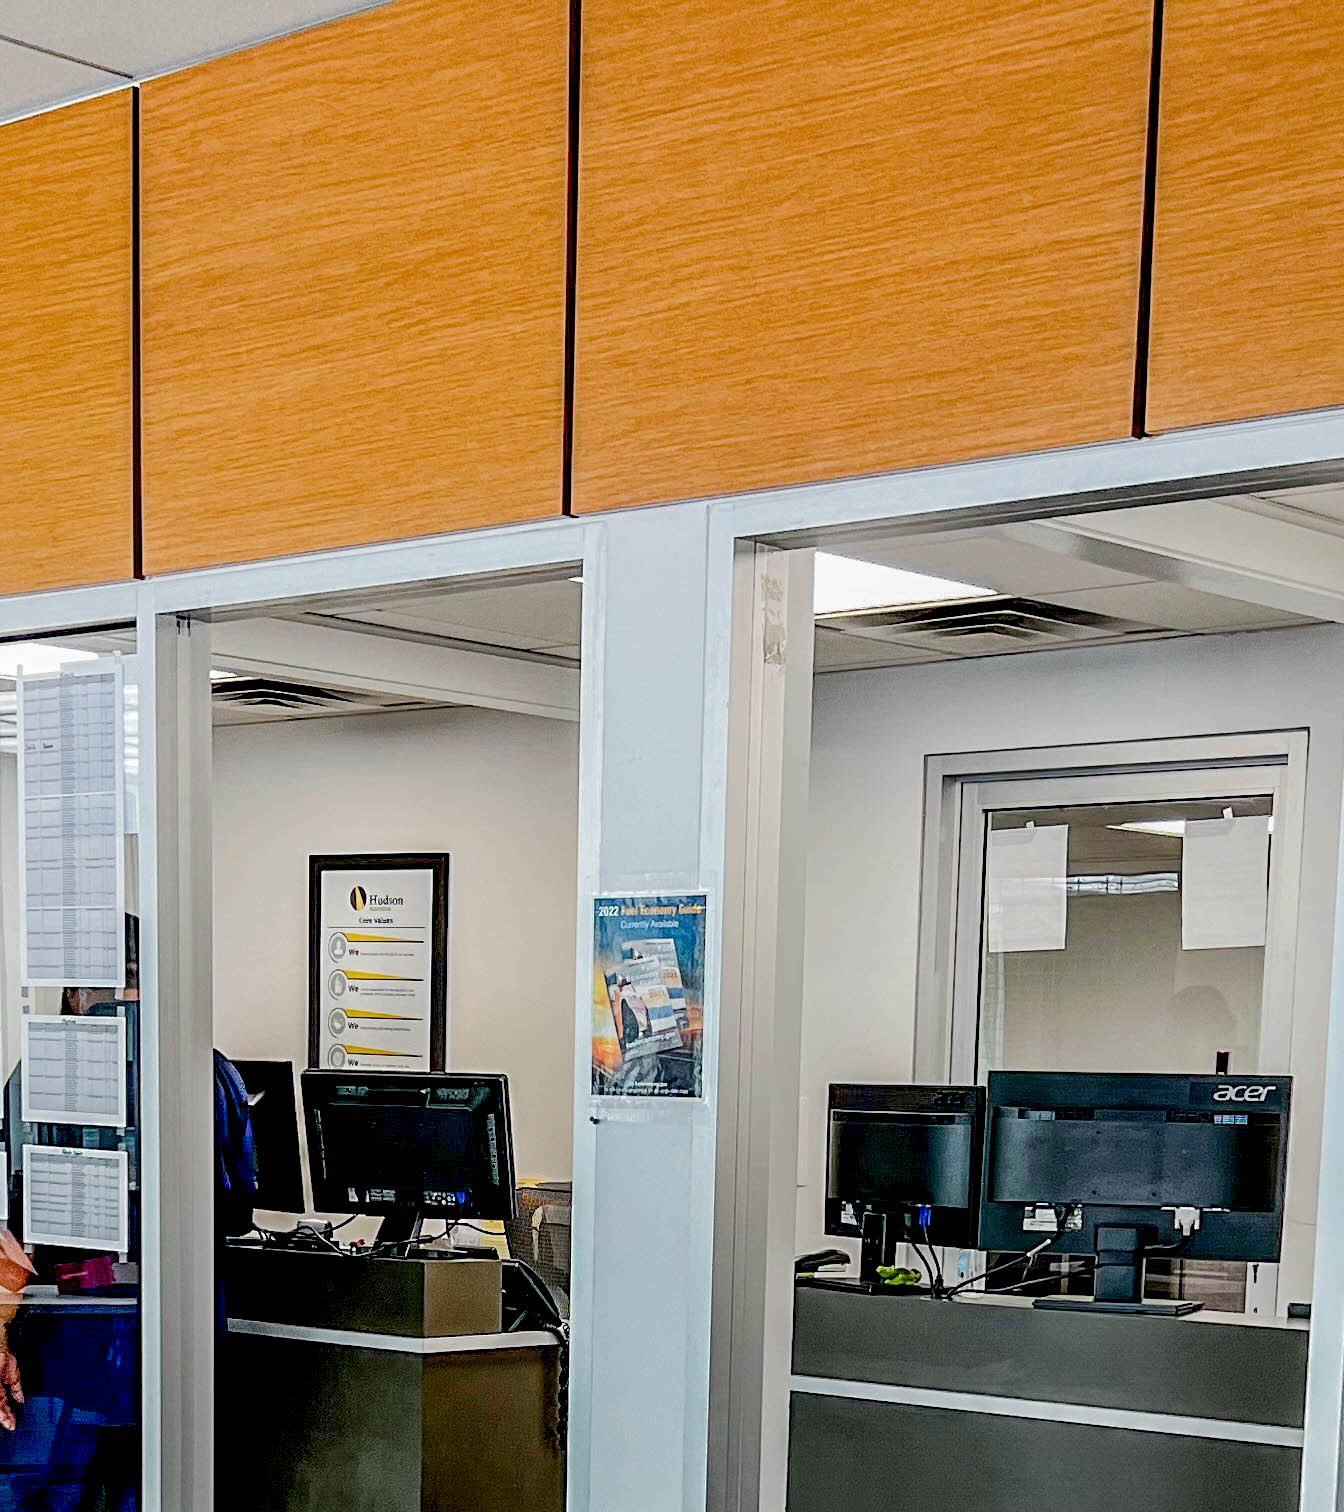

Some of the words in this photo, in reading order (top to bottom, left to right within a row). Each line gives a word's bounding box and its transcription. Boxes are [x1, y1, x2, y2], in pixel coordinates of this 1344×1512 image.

[369, 894, 404, 906] Hudson
[598, 905, 619, 917] 2022
[621, 904, 638, 916] Fuel
[640, 903, 676, 917] Economy
[679, 903, 702, 915] Guide
[348, 948, 360, 956] We
[347, 1022, 359, 1030] We
[347, 1059, 359, 1067] We
[1213, 1085, 1277, 1102] acer
